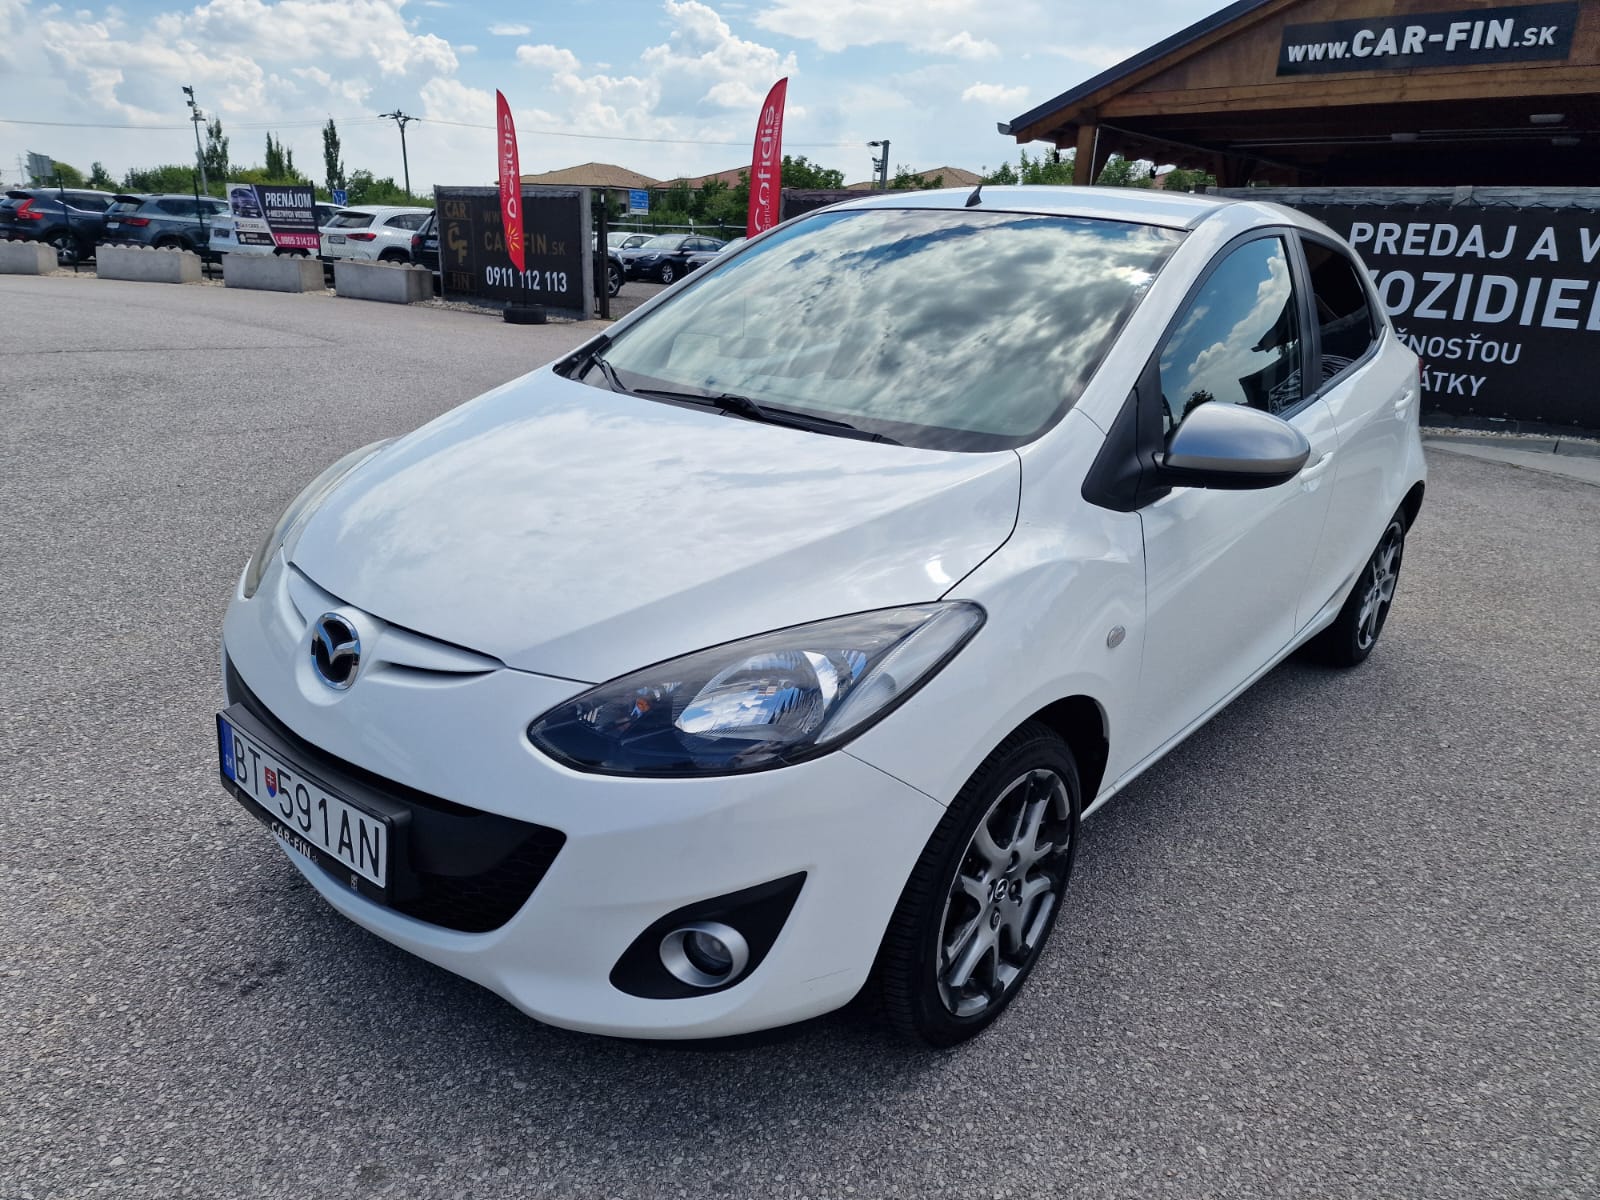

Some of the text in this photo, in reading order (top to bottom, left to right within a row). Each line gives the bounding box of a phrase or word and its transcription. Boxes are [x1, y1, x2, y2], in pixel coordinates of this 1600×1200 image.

[265, 189, 312, 209] PRENÁJOM
[1350, 222, 1600, 263] PREDAJ A V
[486, 266, 567, 292] 0911 112 113
[1396, 327, 1522, 364] ŽNOSŤOU
[1420, 364, 1487, 397] ÁTKY
[234, 735, 380, 878] BT 591AN
